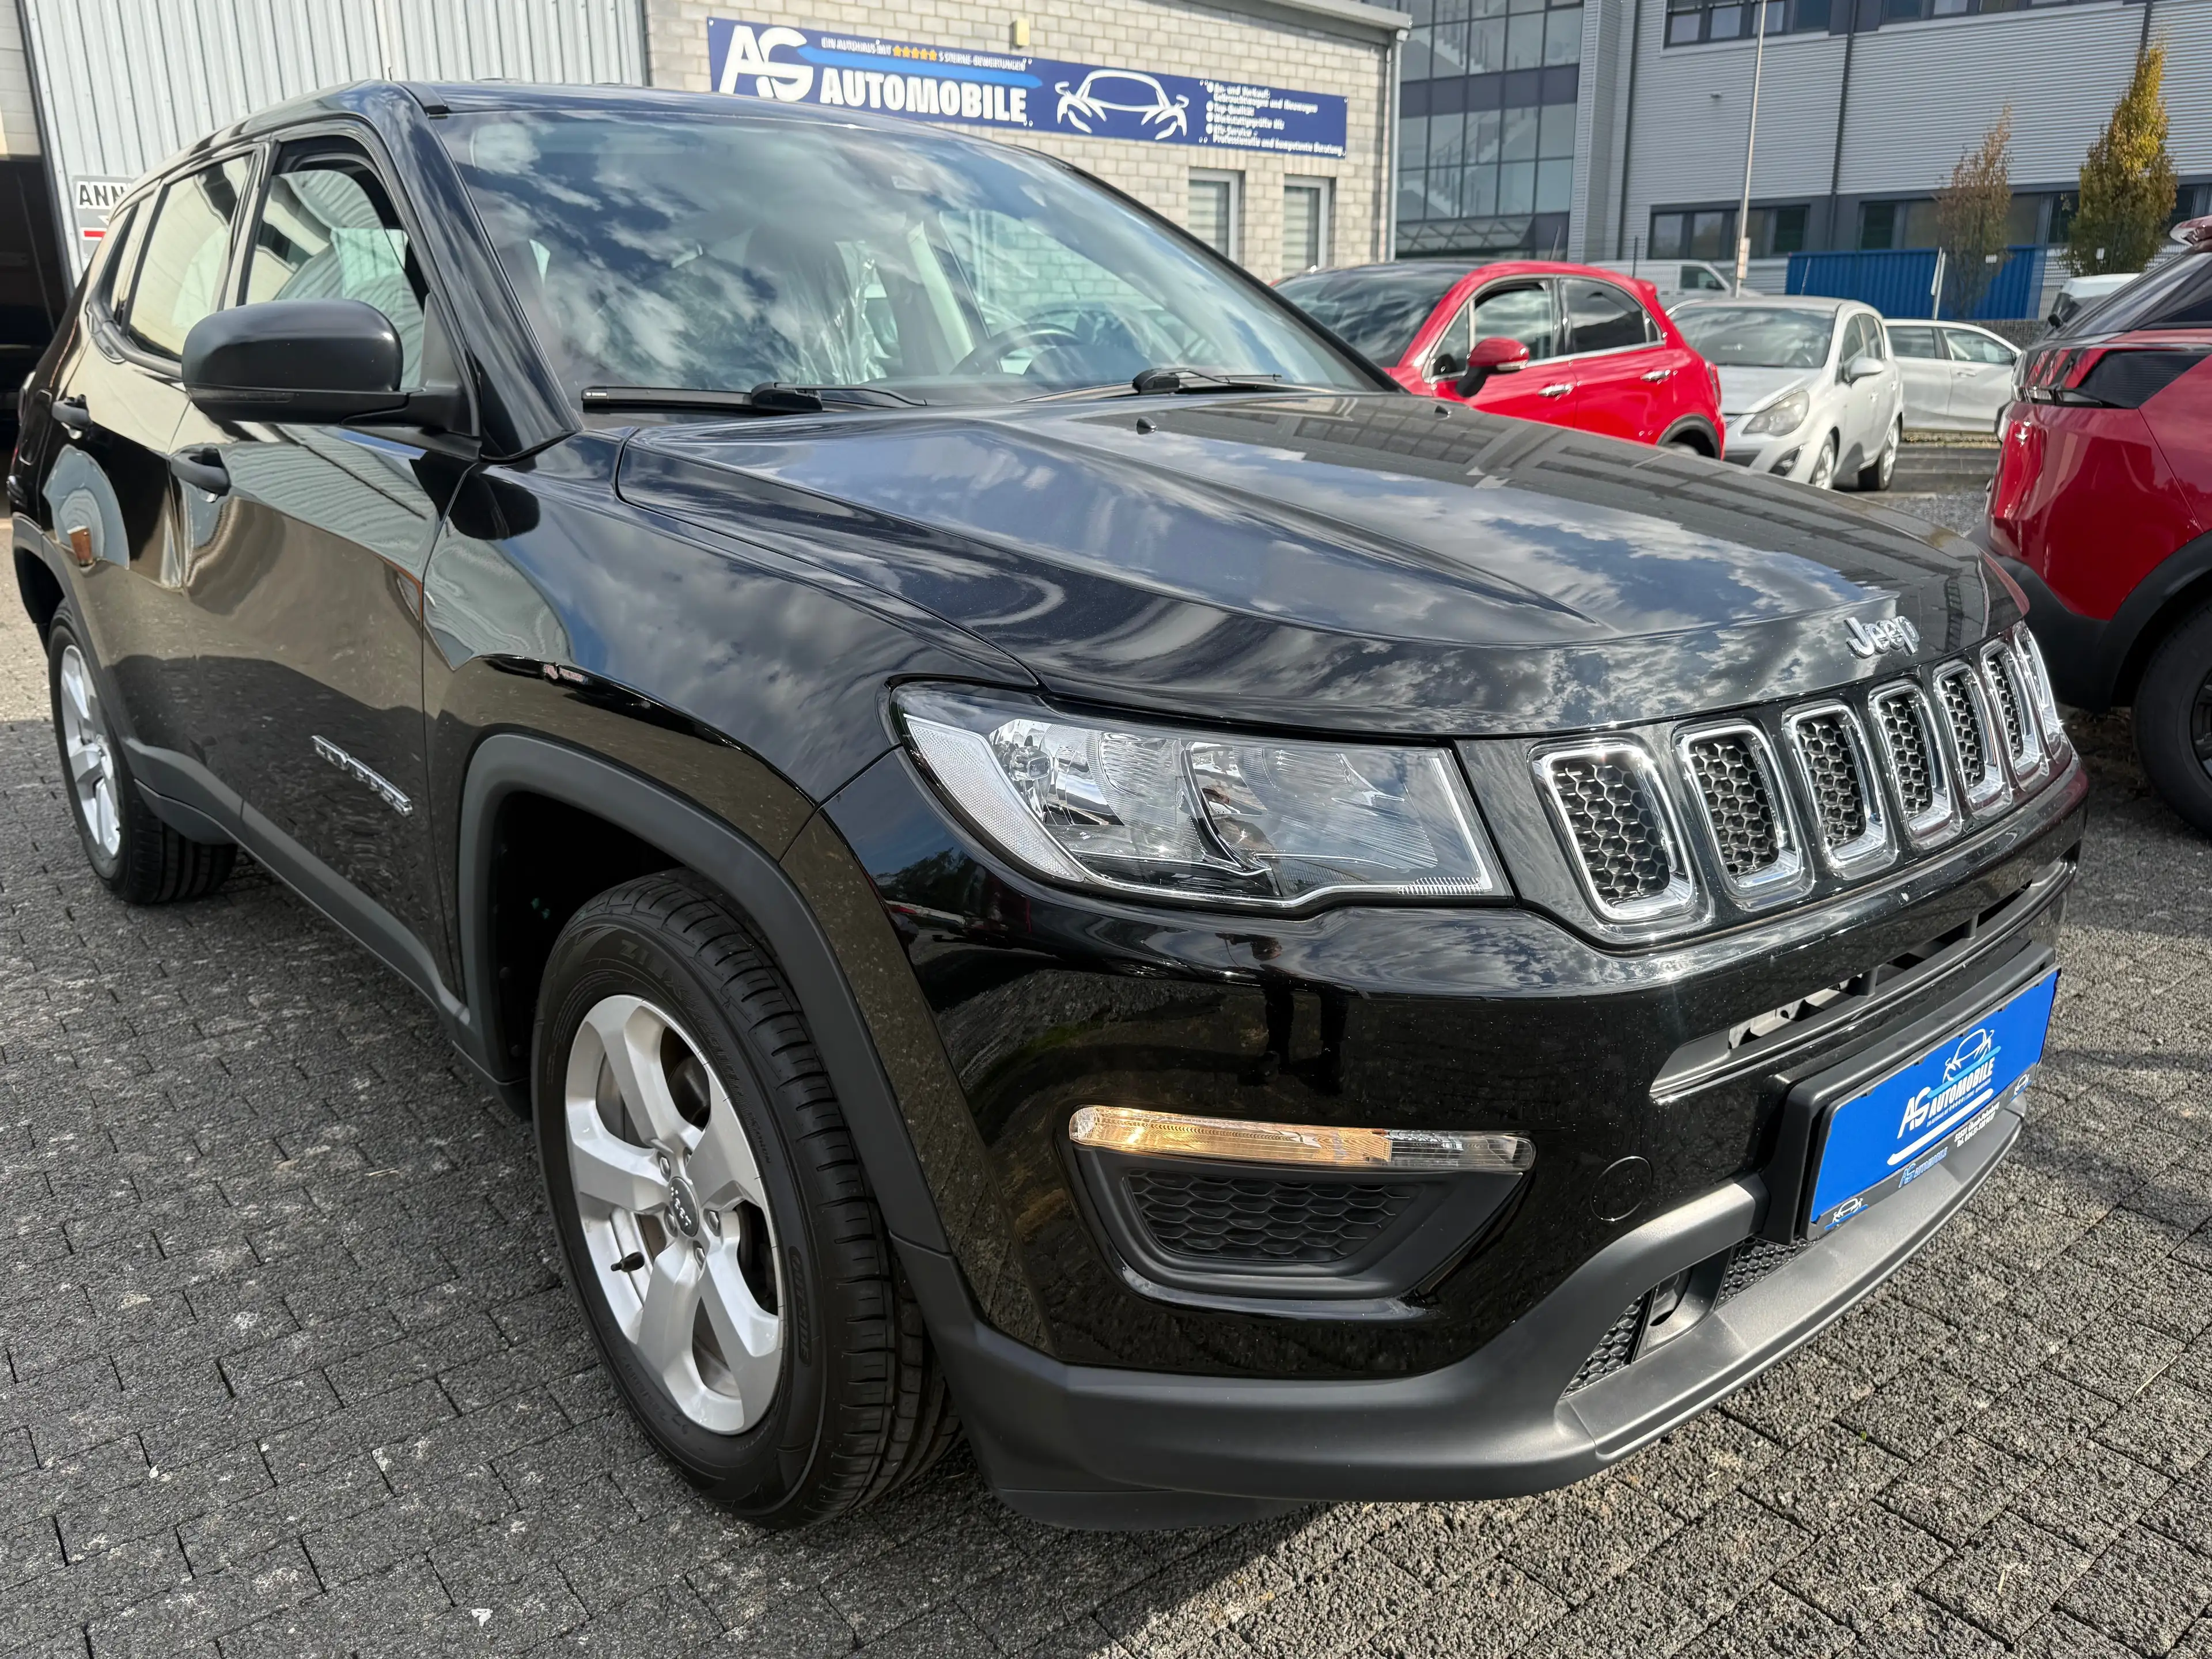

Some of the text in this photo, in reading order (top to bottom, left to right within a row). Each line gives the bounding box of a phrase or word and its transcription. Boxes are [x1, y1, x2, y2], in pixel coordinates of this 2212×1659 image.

[718, 25, 813, 102] AS
[820, 67, 1027, 123] AUTOMOBILE
[1270, 98, 1283, 109] und
[1261, 137, 1275, 148] und
[1844, 616, 1919, 659] Jeep
[1897, 1086, 1931, 1139] AS
[1928, 1056, 1995, 1119] AUTOMOBILE
[790, 1253, 810, 1361] OUTSIDE
